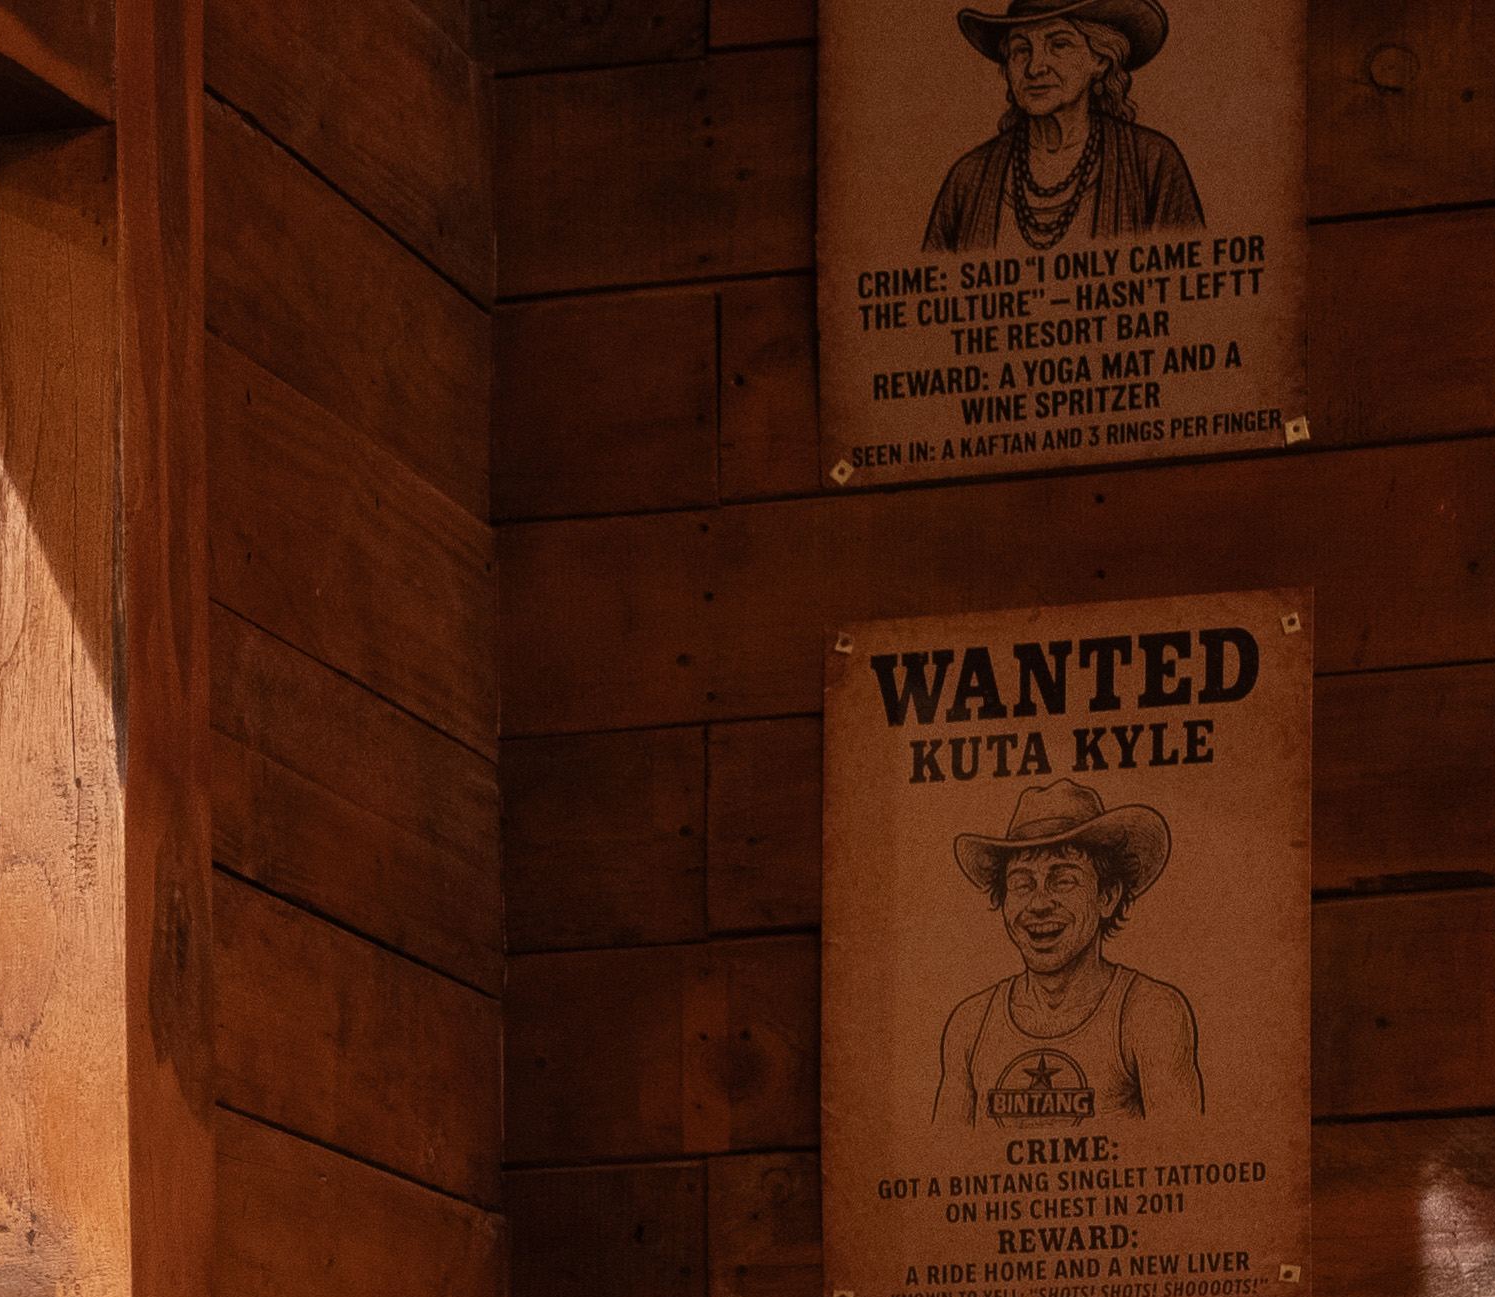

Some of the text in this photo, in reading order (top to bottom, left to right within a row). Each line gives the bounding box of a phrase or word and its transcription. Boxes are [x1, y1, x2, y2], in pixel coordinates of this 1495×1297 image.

[858, 266, 946, 299] CRIME:
[961, 259, 1020, 289] SAID
[1054, 249, 1119, 280] ONLY
[1130, 241, 1201, 273] CAME
[1214, 235, 1264, 265] FOR
[859, 302, 906, 331] THE
[1077, 277, 1170, 311] HASN'T
[1181, 268, 1264, 301] LEFTT
[951, 311, 1169, 355] THE RESORT BAR
[874, 341, 1241, 400] REWARD: A YOGA MAT AND A
[962, 382, 1160, 425] WINE SPRITZER
[852, 408, 1283, 469] SEEN IN: A KAFTAN AND 3 RINGS PER FINGER
[870, 627, 1259, 729] WANTED
[909, 719, 1213, 784] KUTA KYLE
[995, 1092, 1089, 1116] BINTANG
[1007, 1136, 1118, 1165] CRIME:
[878, 1162, 1265, 1200] GOT A BINTANG SINGLET TATTOOED
[946, 1193, 1183, 1223] ON HIS CHEST IN 2011
[998, 1225, 1137, 1254] REWARD:
[906, 1252, 1249, 1285] A RIDE HOME AND A NEW LIVER
